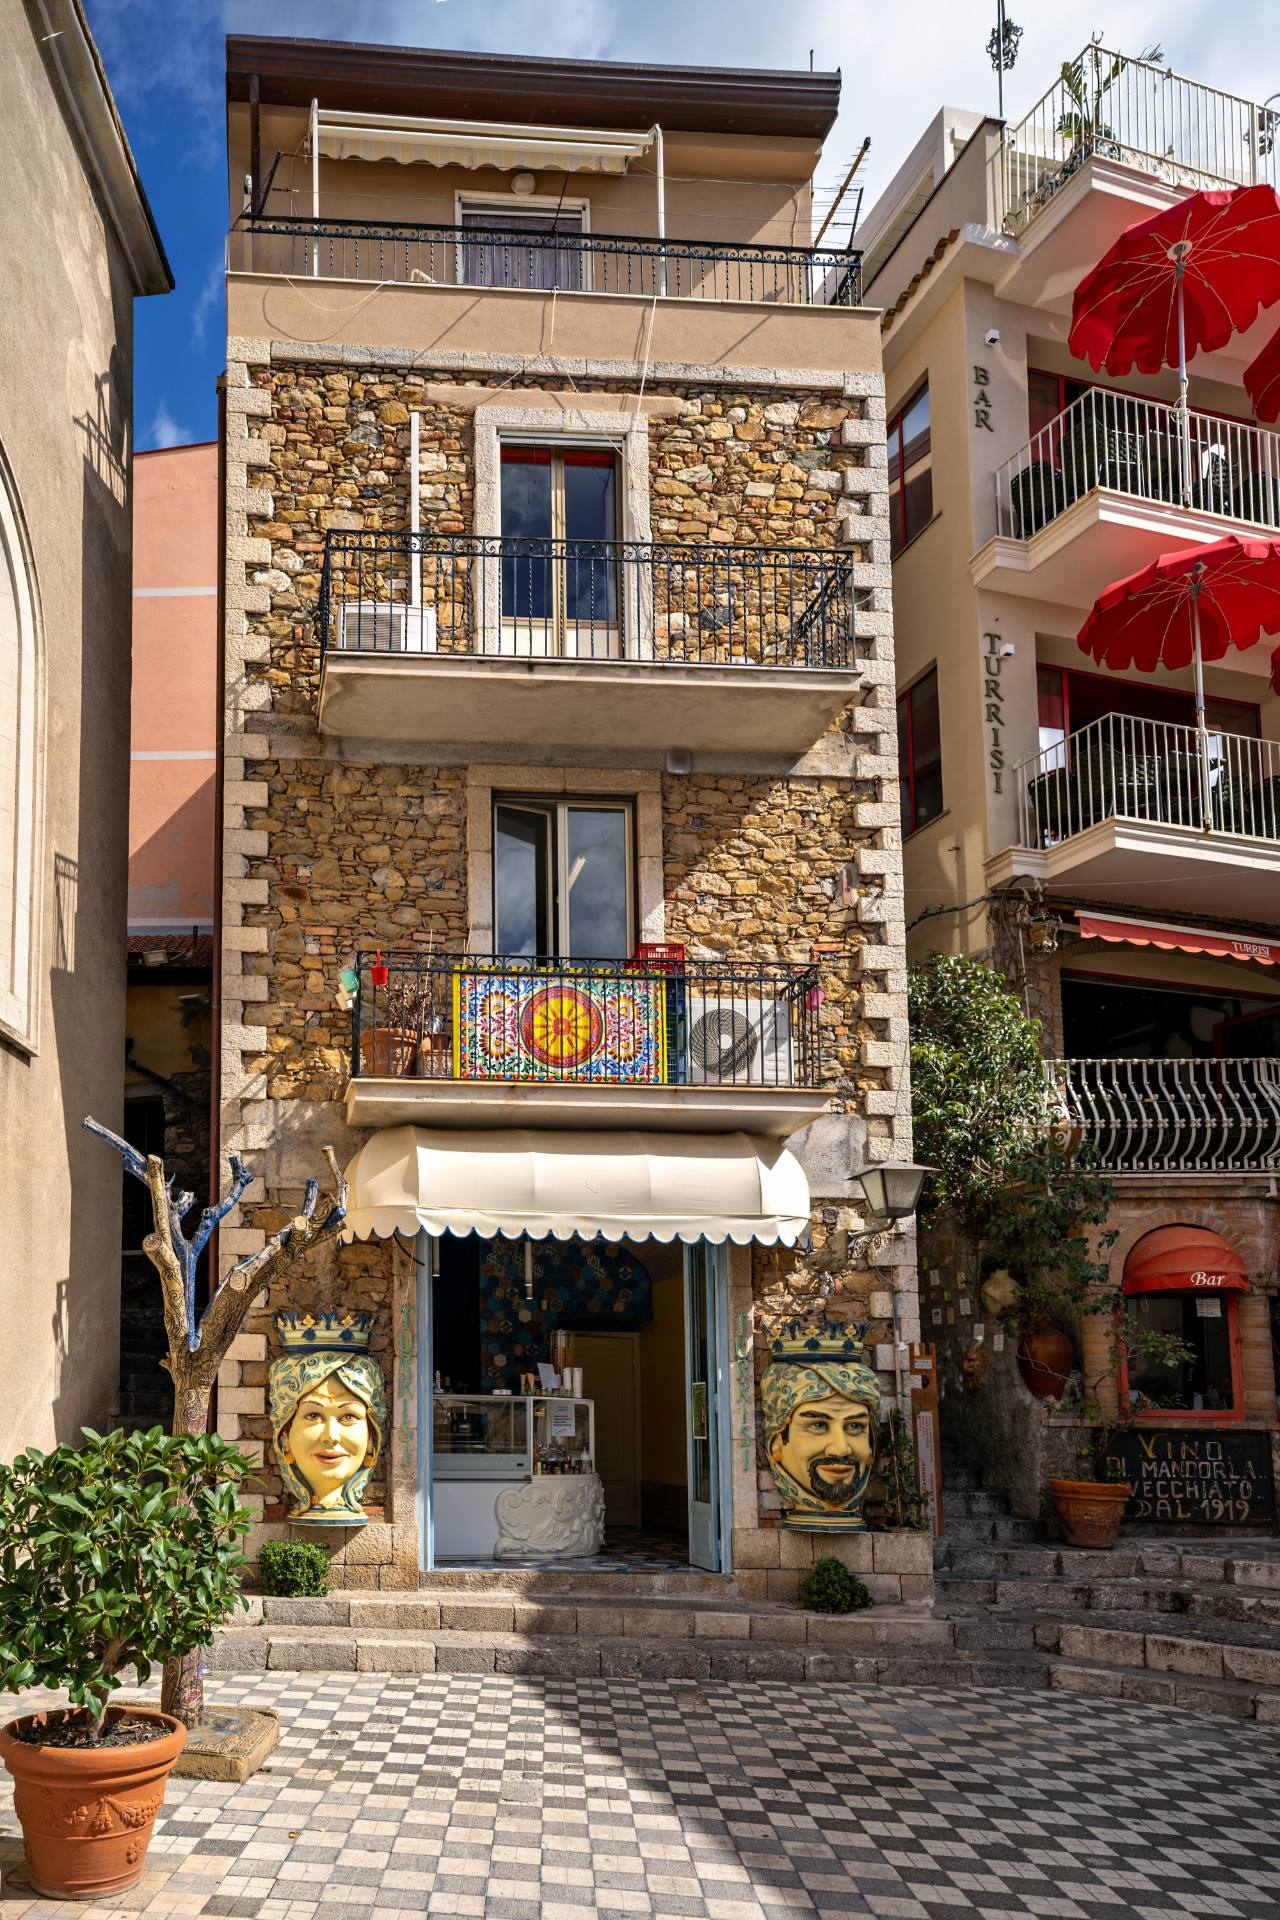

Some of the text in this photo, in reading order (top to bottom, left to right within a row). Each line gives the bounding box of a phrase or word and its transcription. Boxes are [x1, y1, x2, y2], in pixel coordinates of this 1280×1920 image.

[973, 365, 994, 433] BAR
[982, 632, 1005, 794] TURRISI
[1231, 941, 1270, 957] TURRISI
[1190, 1271, 1226, 1287] Bar
[398, 1304, 415, 1468] TURRISI
[735, 1311, 752, 1473] TURRISI
